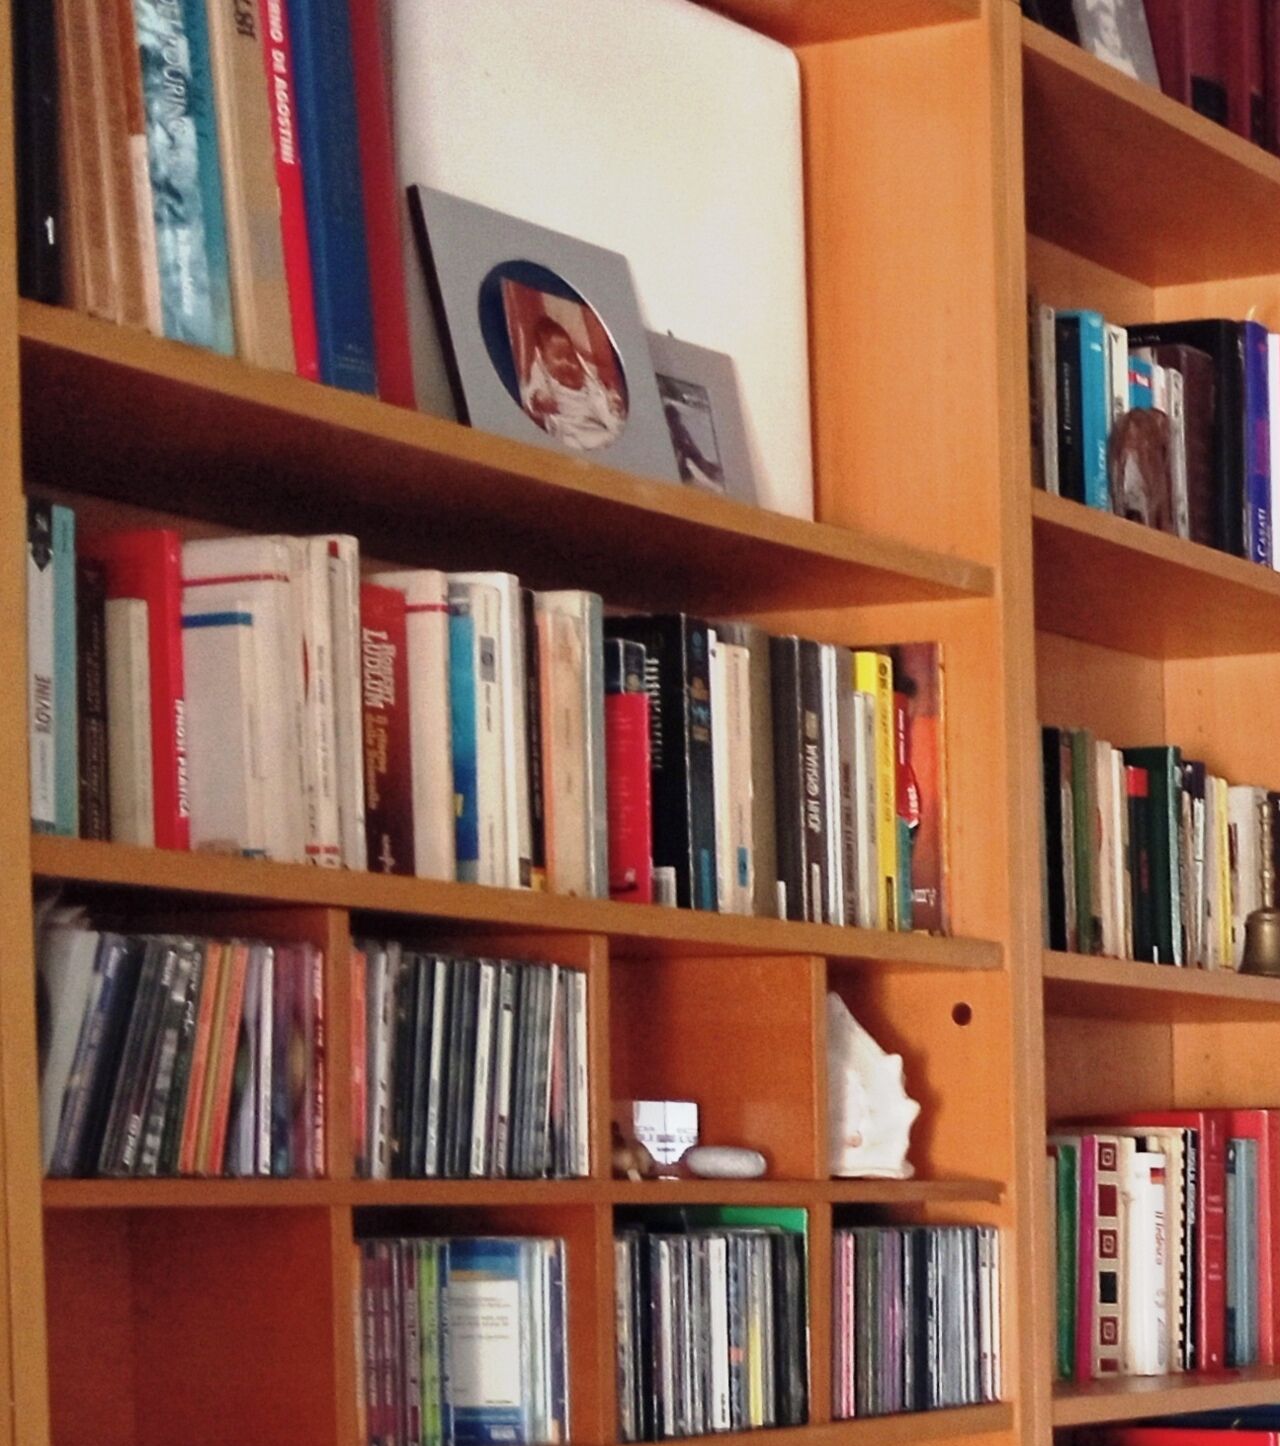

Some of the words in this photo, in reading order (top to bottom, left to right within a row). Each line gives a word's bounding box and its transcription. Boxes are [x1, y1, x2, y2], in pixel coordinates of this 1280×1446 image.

[274, 75, 294, 165] AGOSTINI
[1255, 507, 1267, 558] CASATI
[362, 628, 384, 710] LUDLUM
[174, 699, 187, 752] IPNOSI
[176, 756, 190, 819] PRATICA
[805, 745, 819, 797] GRISHAM
[806, 800, 820, 833] JOHN
